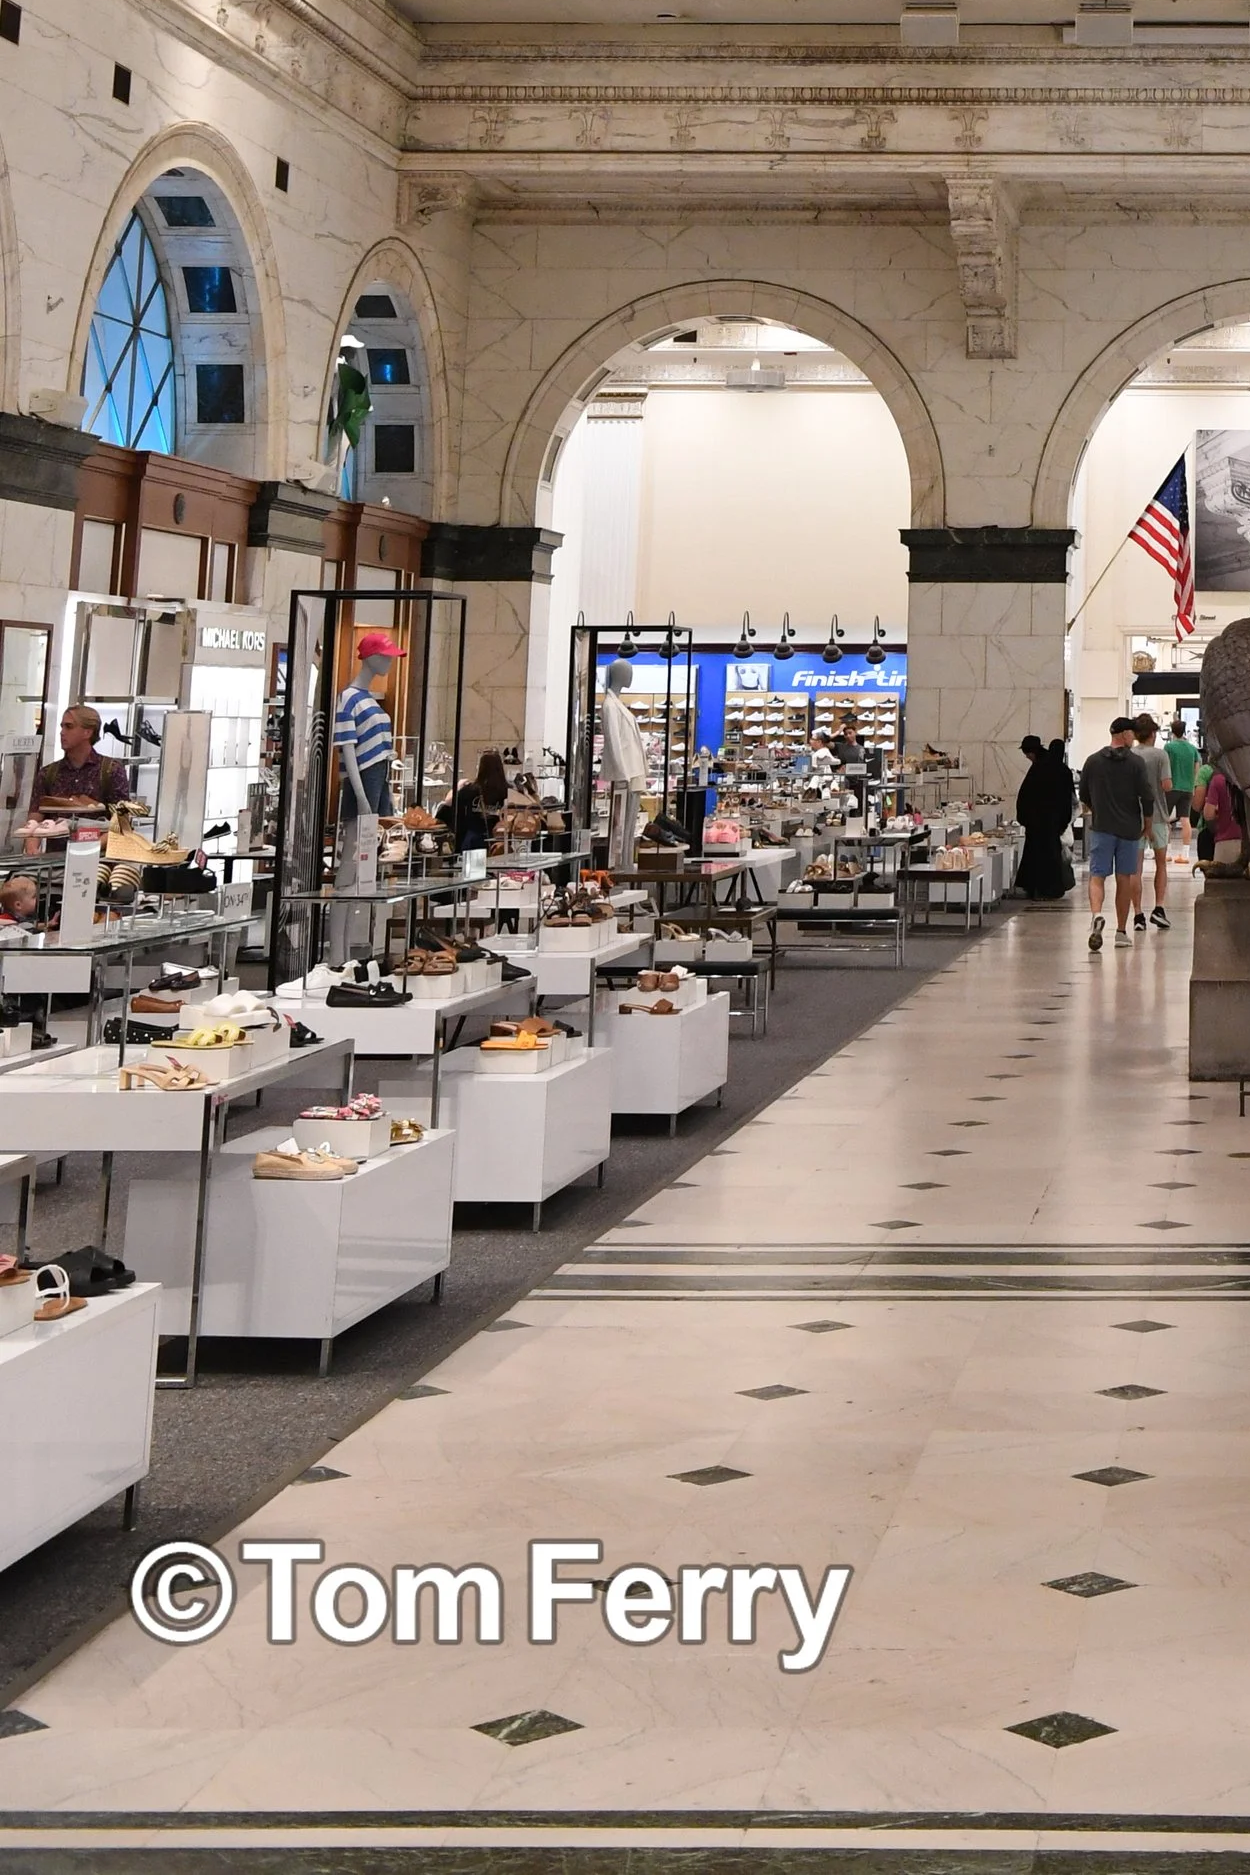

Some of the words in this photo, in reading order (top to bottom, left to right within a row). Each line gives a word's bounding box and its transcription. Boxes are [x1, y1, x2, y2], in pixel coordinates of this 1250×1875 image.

[202, 627, 240, 648] MICHAEL
[242, 630, 266, 651] KORS
[791, 670, 865, 686] Finish
[876, 670, 907, 686] Lin
